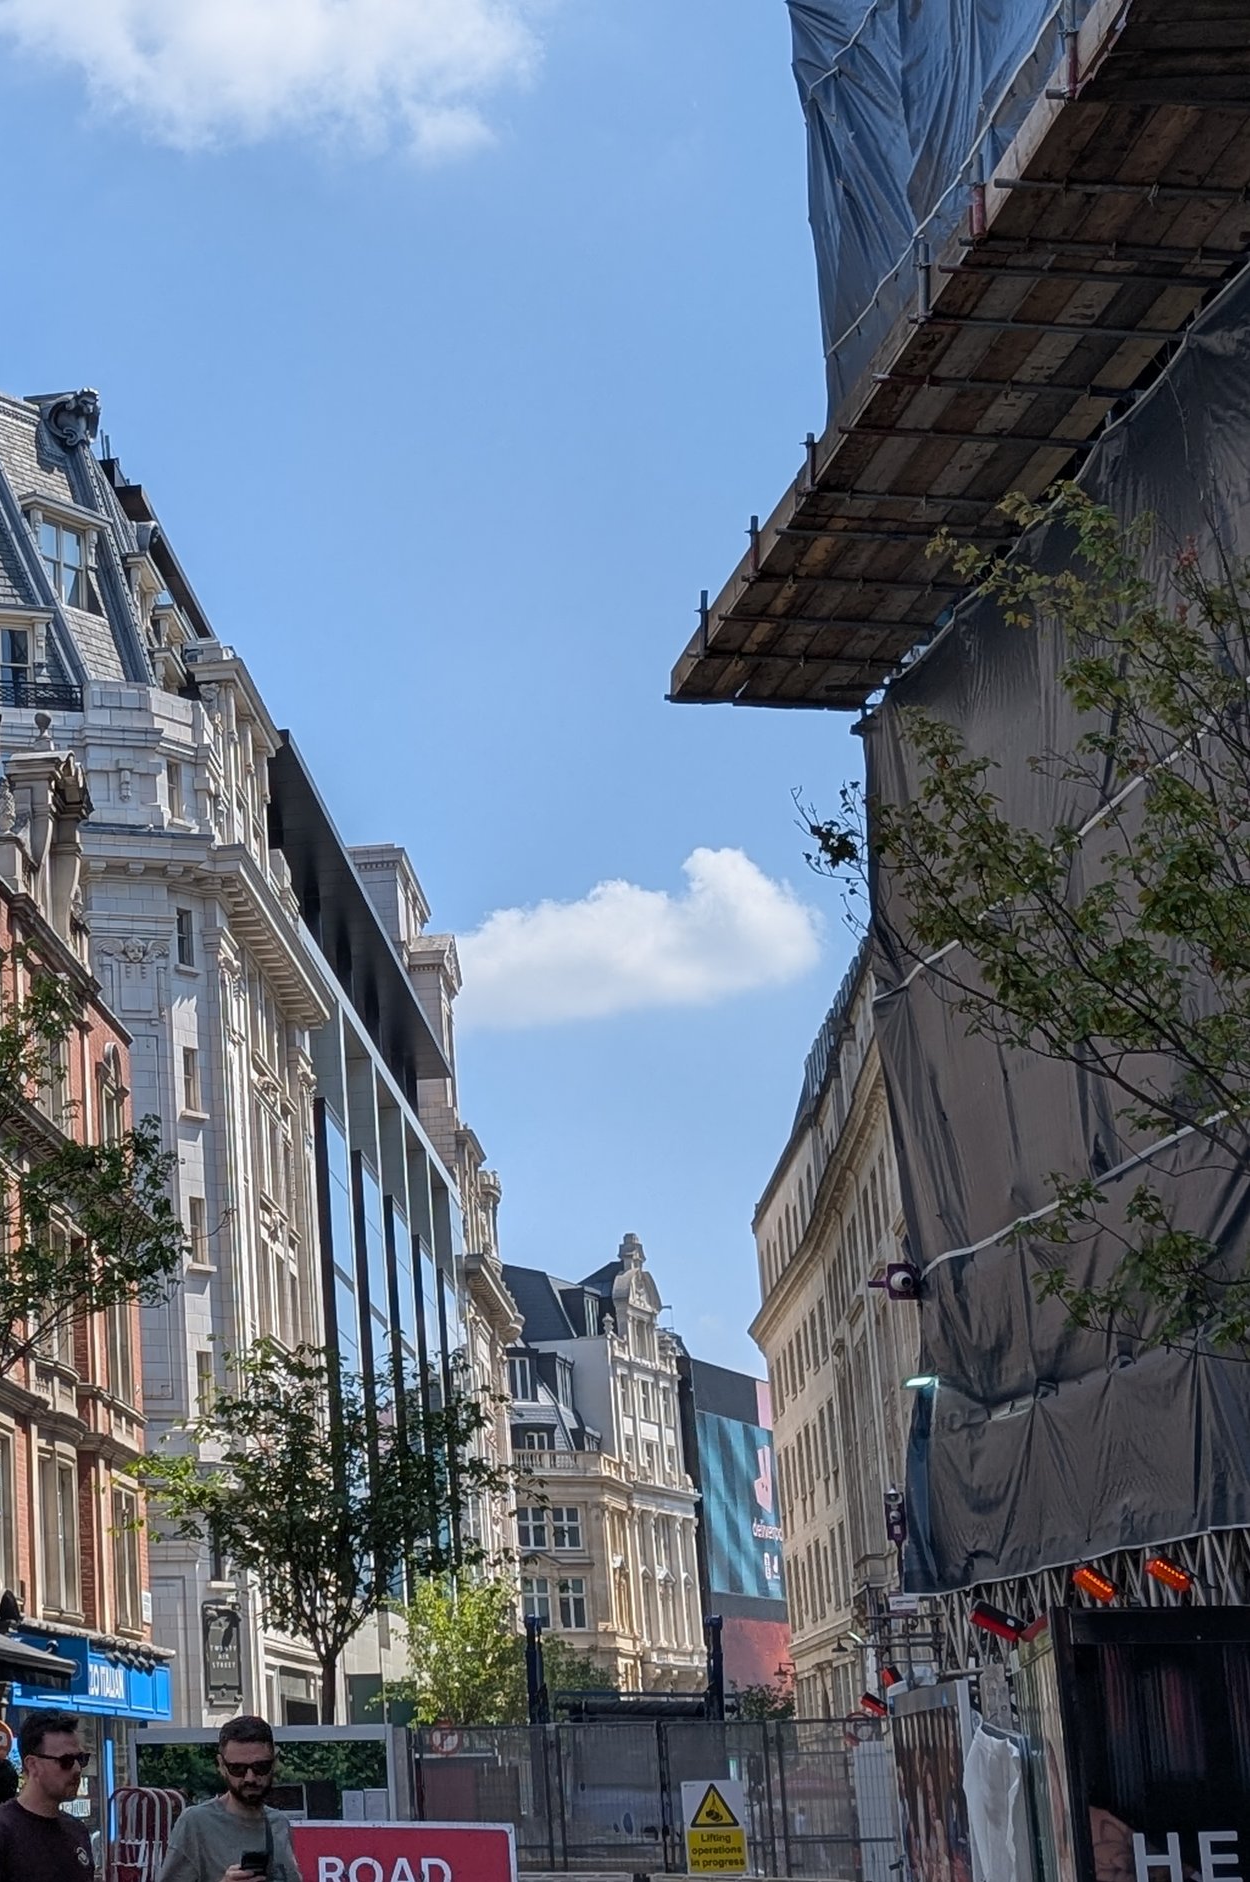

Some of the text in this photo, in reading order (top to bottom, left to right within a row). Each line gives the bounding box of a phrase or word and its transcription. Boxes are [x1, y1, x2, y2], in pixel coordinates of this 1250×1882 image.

[211, 1661, 236, 1669] STREET
[700, 1833, 731, 1844] Lifting
[691, 1845, 742, 1856] operations
[318, 1856, 452, 1882] ROAD
[691, 1859, 745, 1868] in progress
